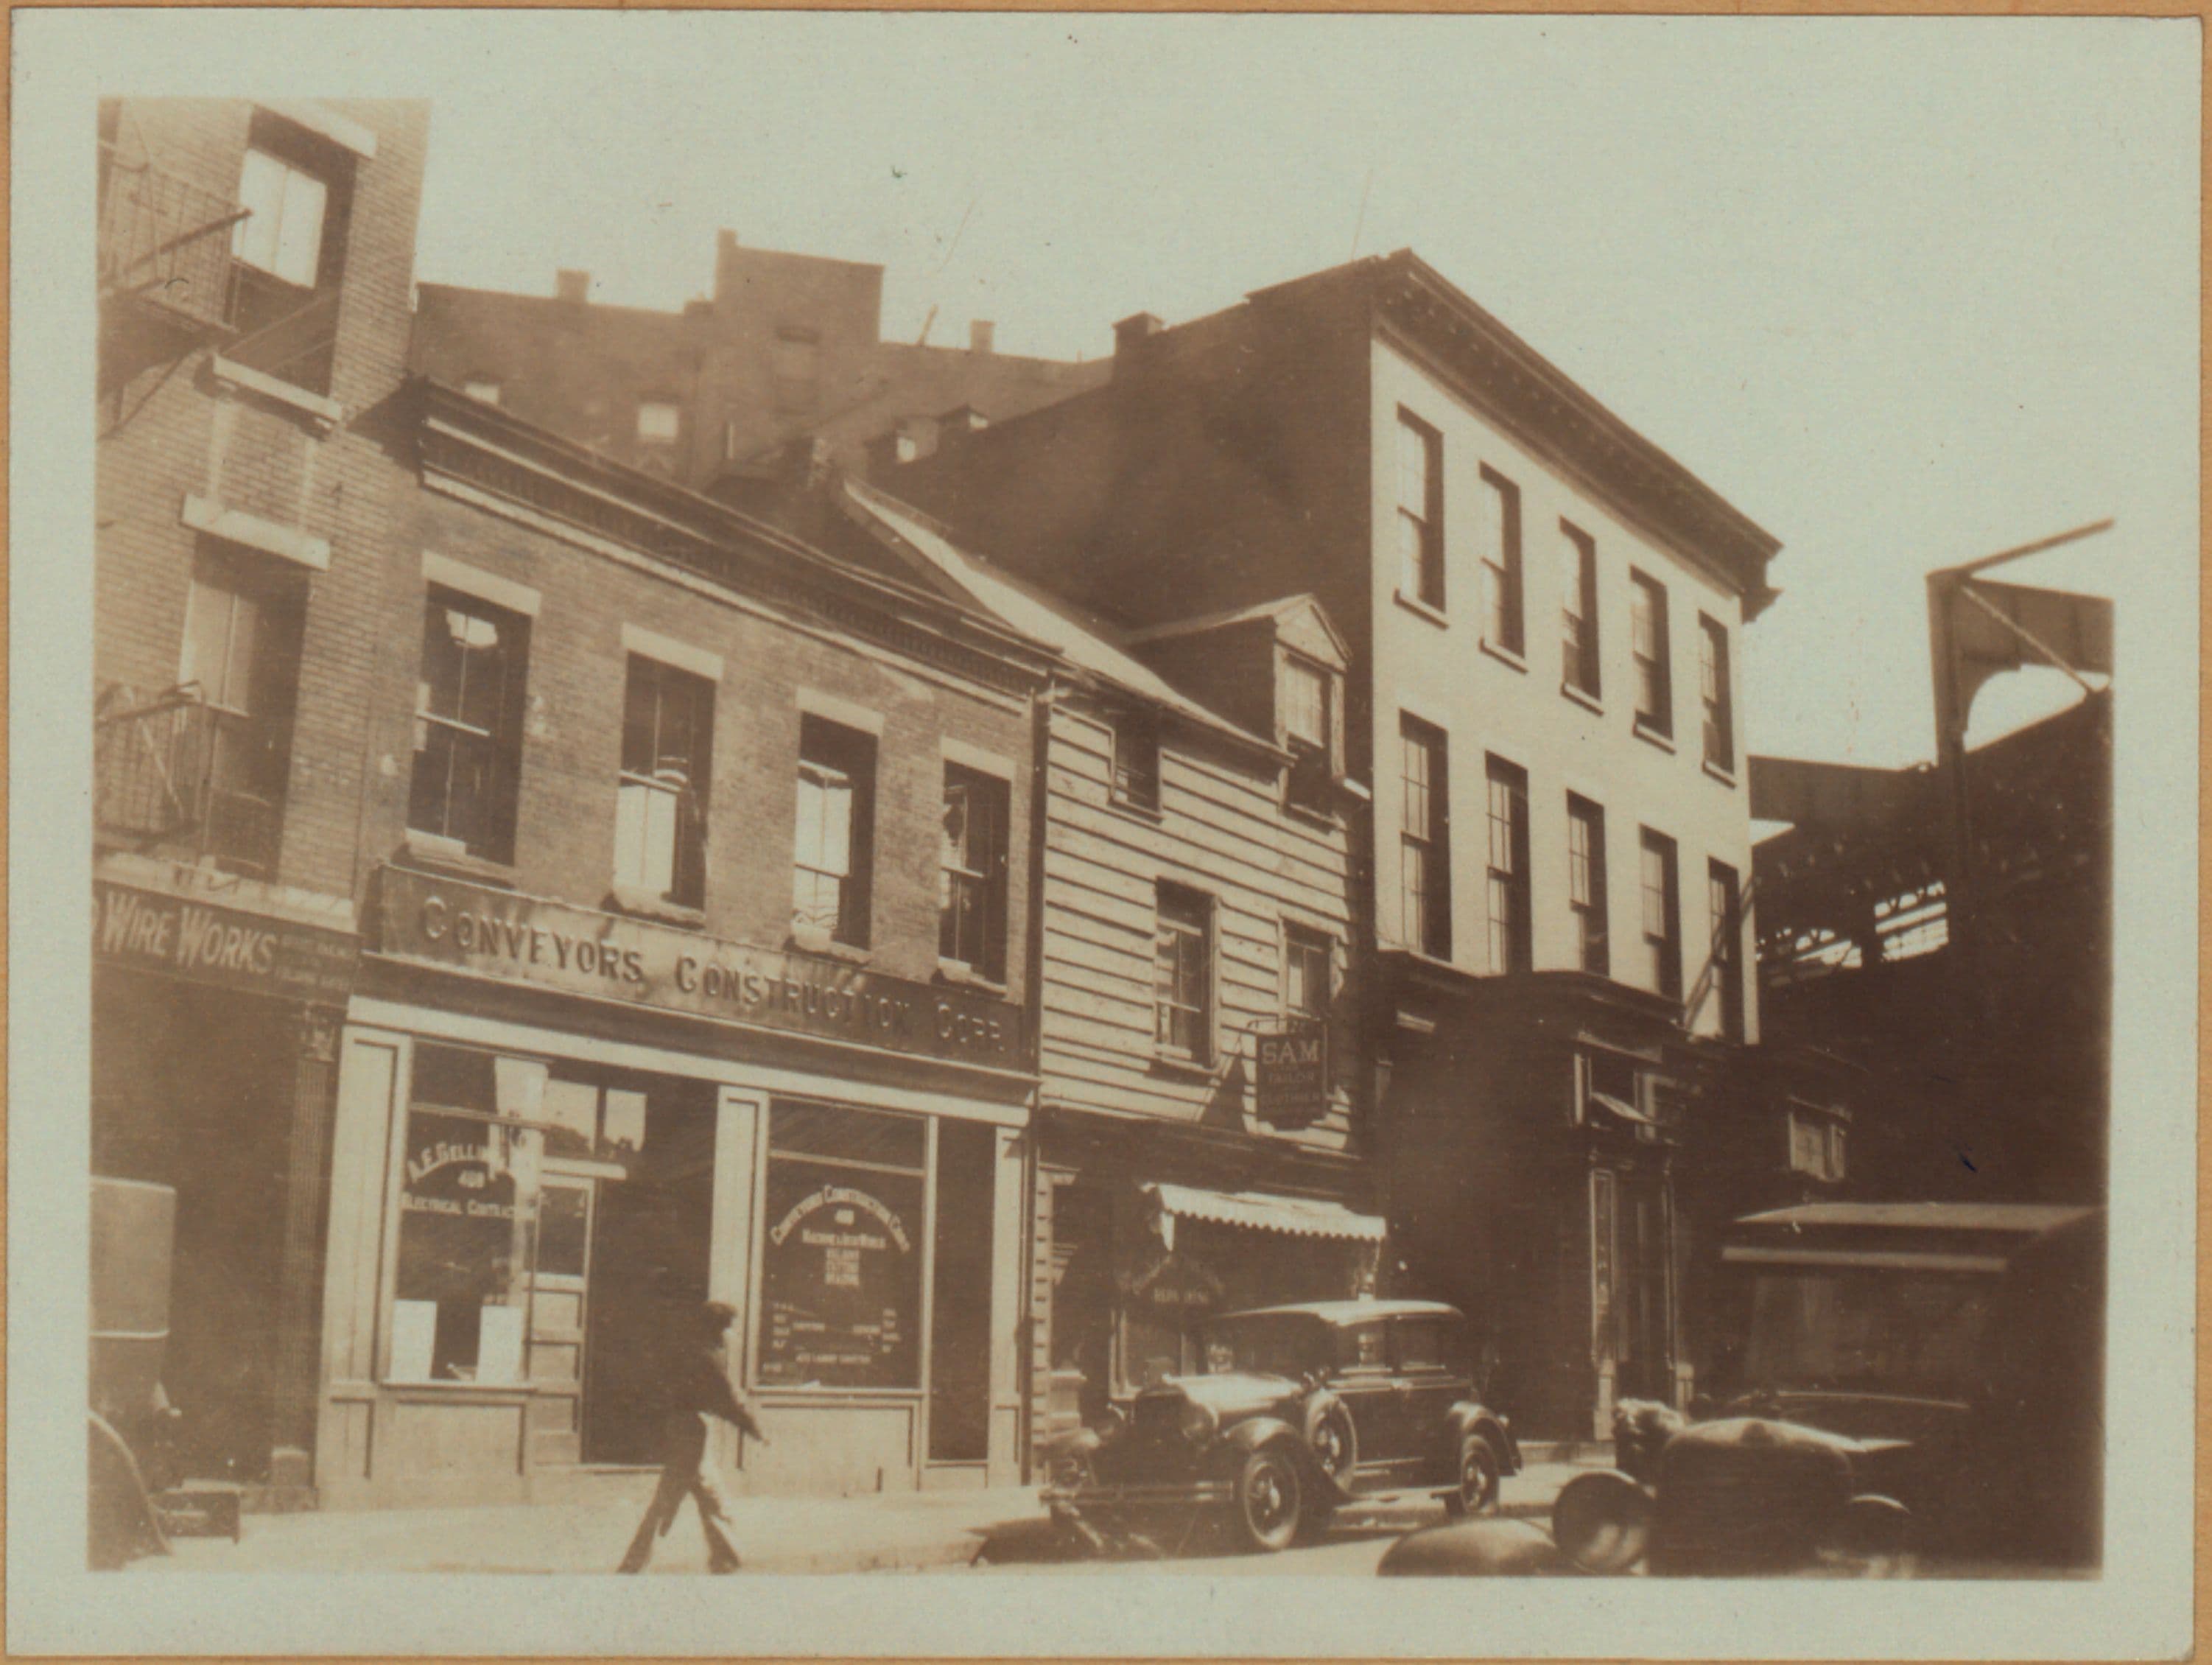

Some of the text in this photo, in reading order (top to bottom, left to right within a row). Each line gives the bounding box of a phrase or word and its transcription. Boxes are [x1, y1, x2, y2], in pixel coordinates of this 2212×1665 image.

[102, 890, 173, 956] WIRE
[176, 905, 277, 974] WORKS
[420, 895, 644, 983] CONVEYORS
[674, 955, 910, 1034] CONSTRUCTION
[1262, 1040, 1319, 1065] SAM
